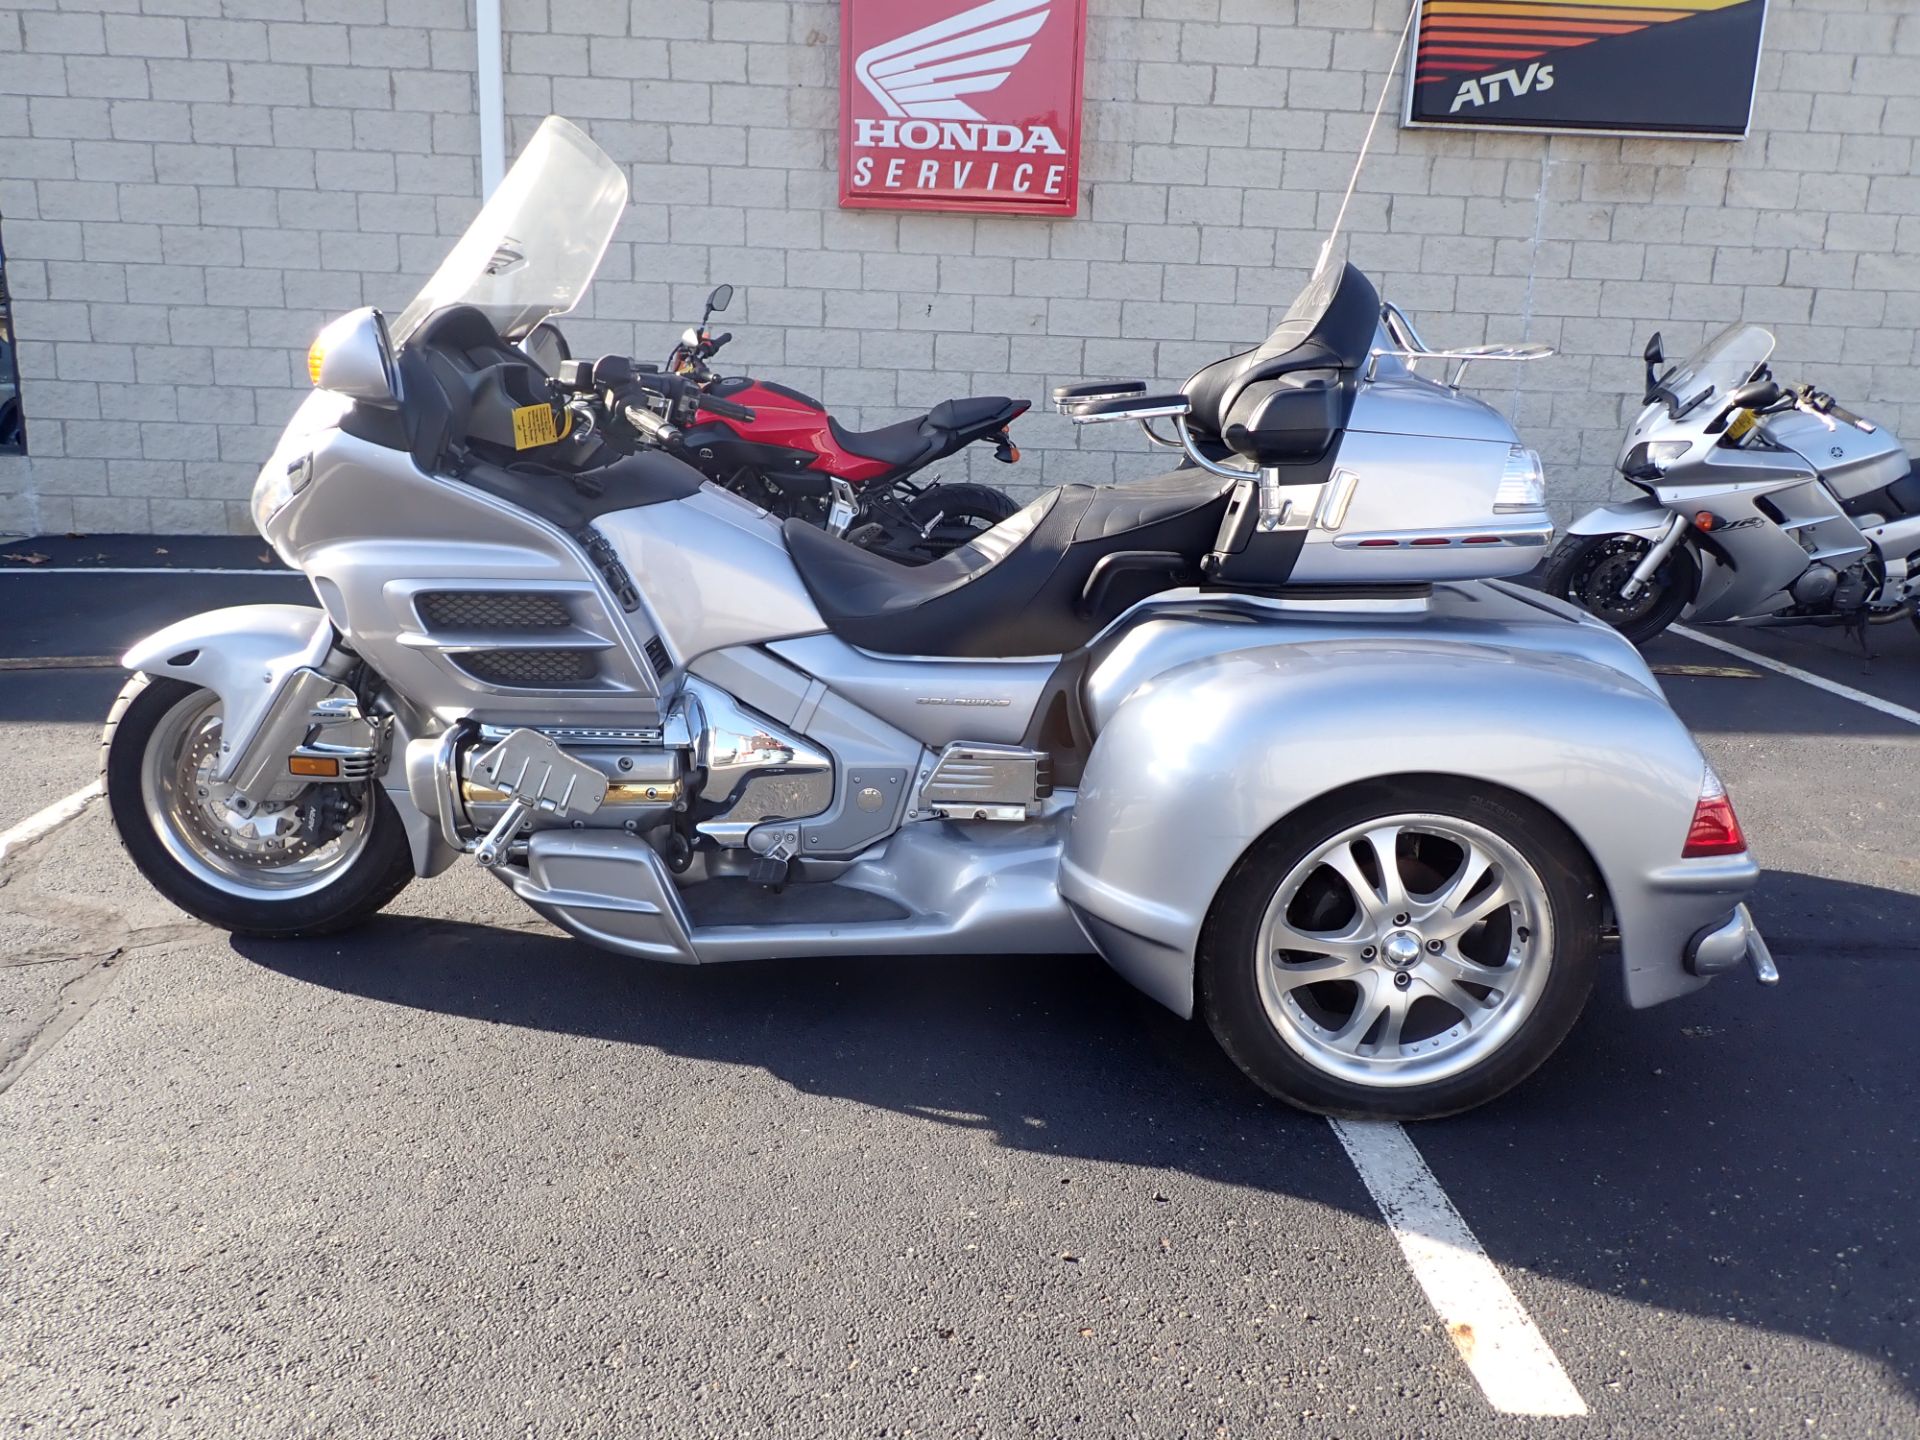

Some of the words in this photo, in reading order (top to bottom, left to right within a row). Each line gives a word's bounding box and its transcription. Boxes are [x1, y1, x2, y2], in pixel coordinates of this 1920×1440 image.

[1449, 62, 1554, 113] ATVs
[854, 119, 1066, 154] HONDA
[854, 157, 1065, 194] SERVICE
